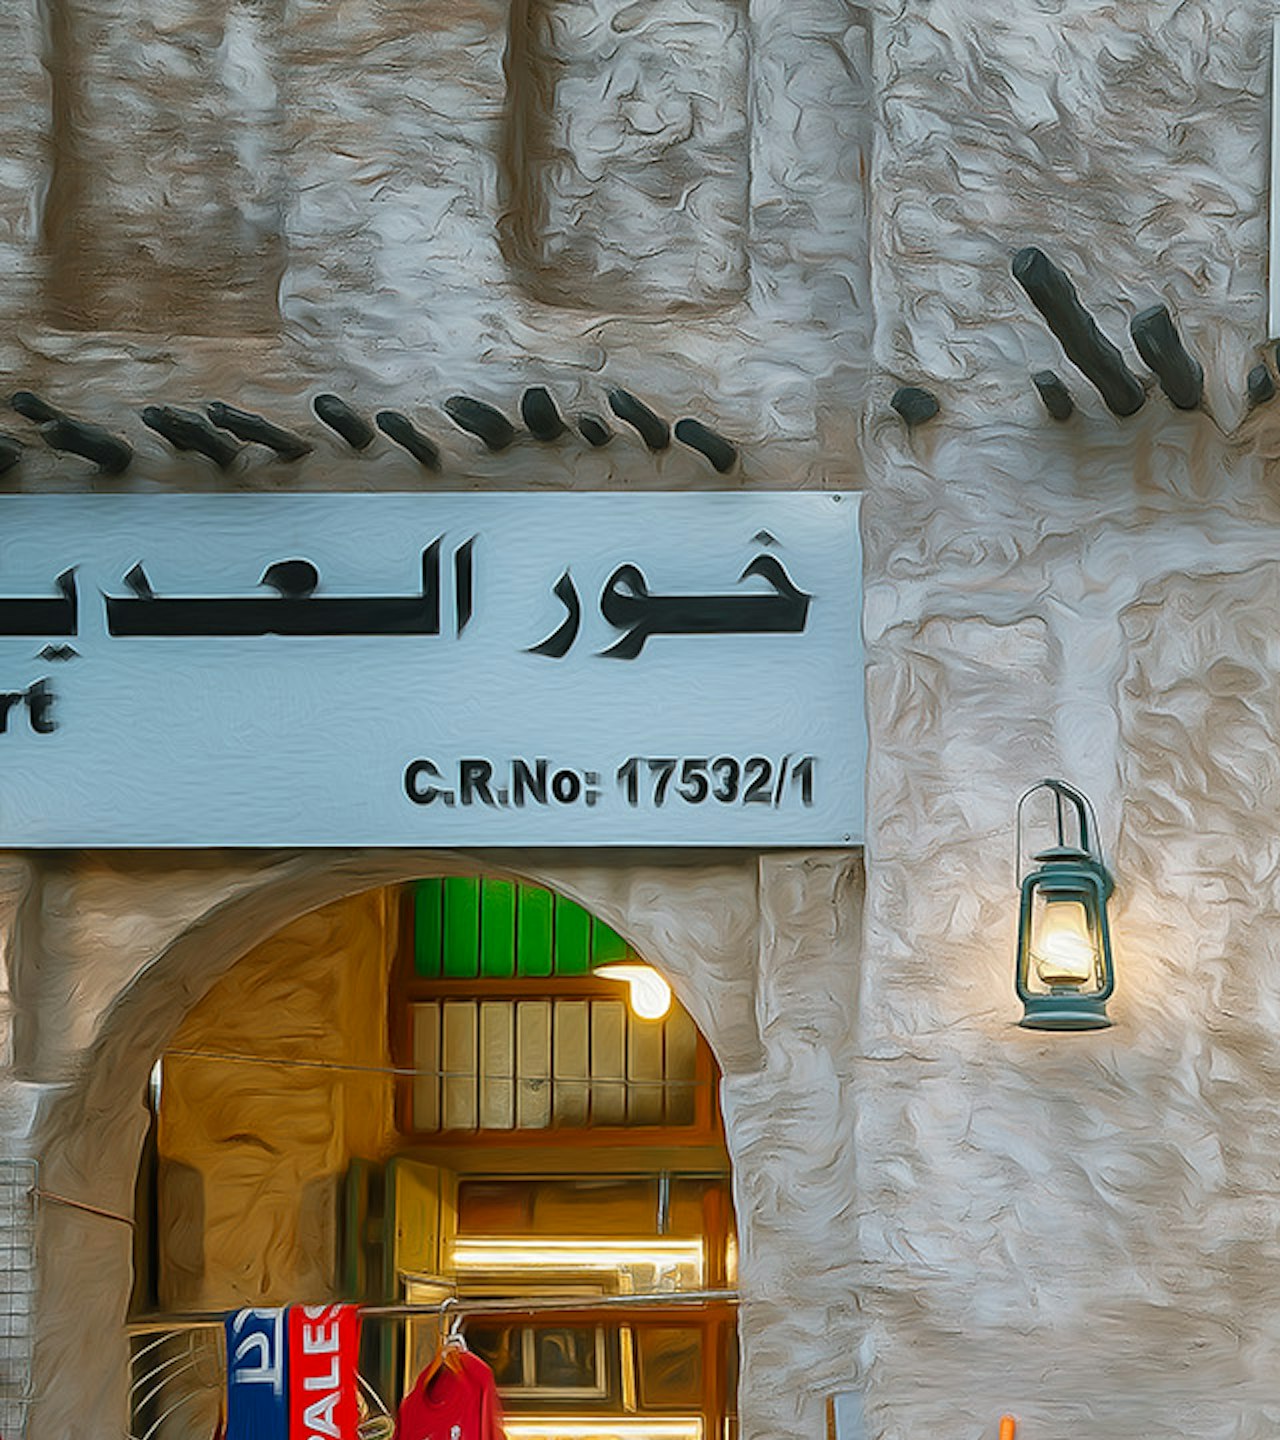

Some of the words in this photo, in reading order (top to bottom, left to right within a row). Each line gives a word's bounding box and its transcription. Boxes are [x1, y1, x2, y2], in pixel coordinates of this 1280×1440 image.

[524, 529, 812, 660] خور
[403, 757, 600, 808] C.R.No:
[615, 755, 815, 809] 17532/1
